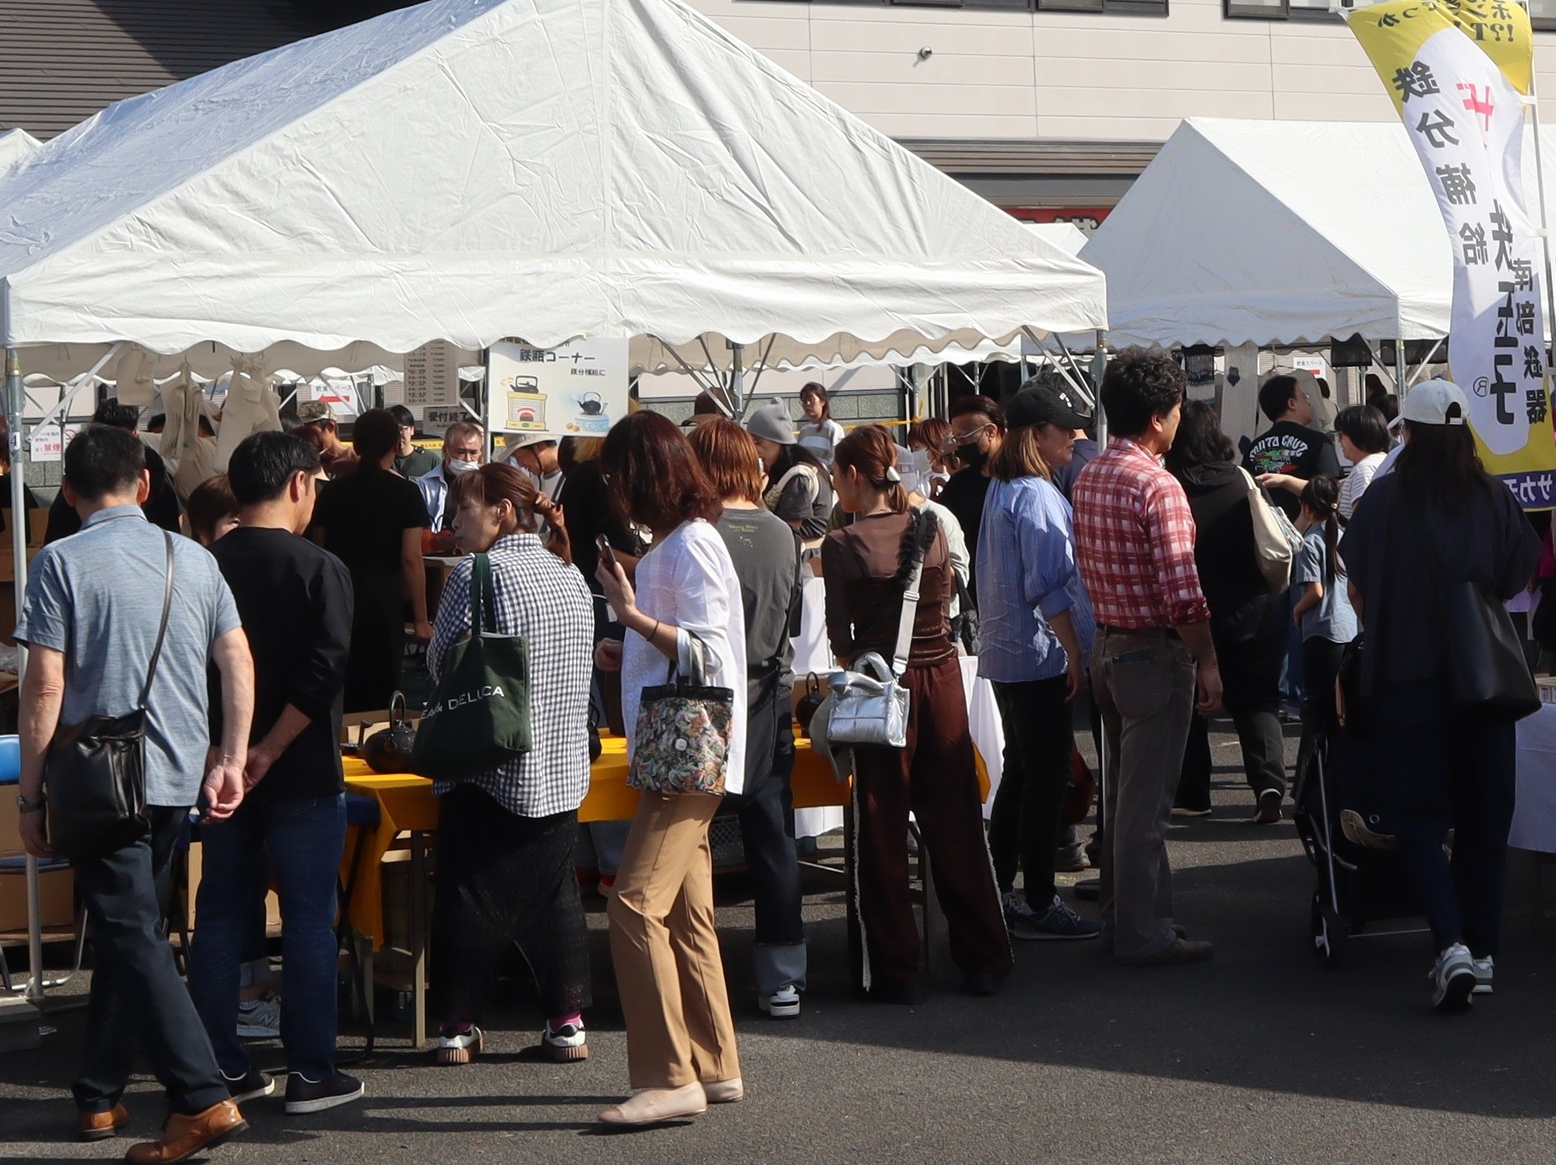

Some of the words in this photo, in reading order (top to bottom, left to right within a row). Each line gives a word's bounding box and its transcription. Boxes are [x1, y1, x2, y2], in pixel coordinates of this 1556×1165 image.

[520, 349, 596, 364] 鉄瓶コーナー
[1281, 434, 1309, 458] CRUZ
[448, 685, 505, 711] DELUCA
